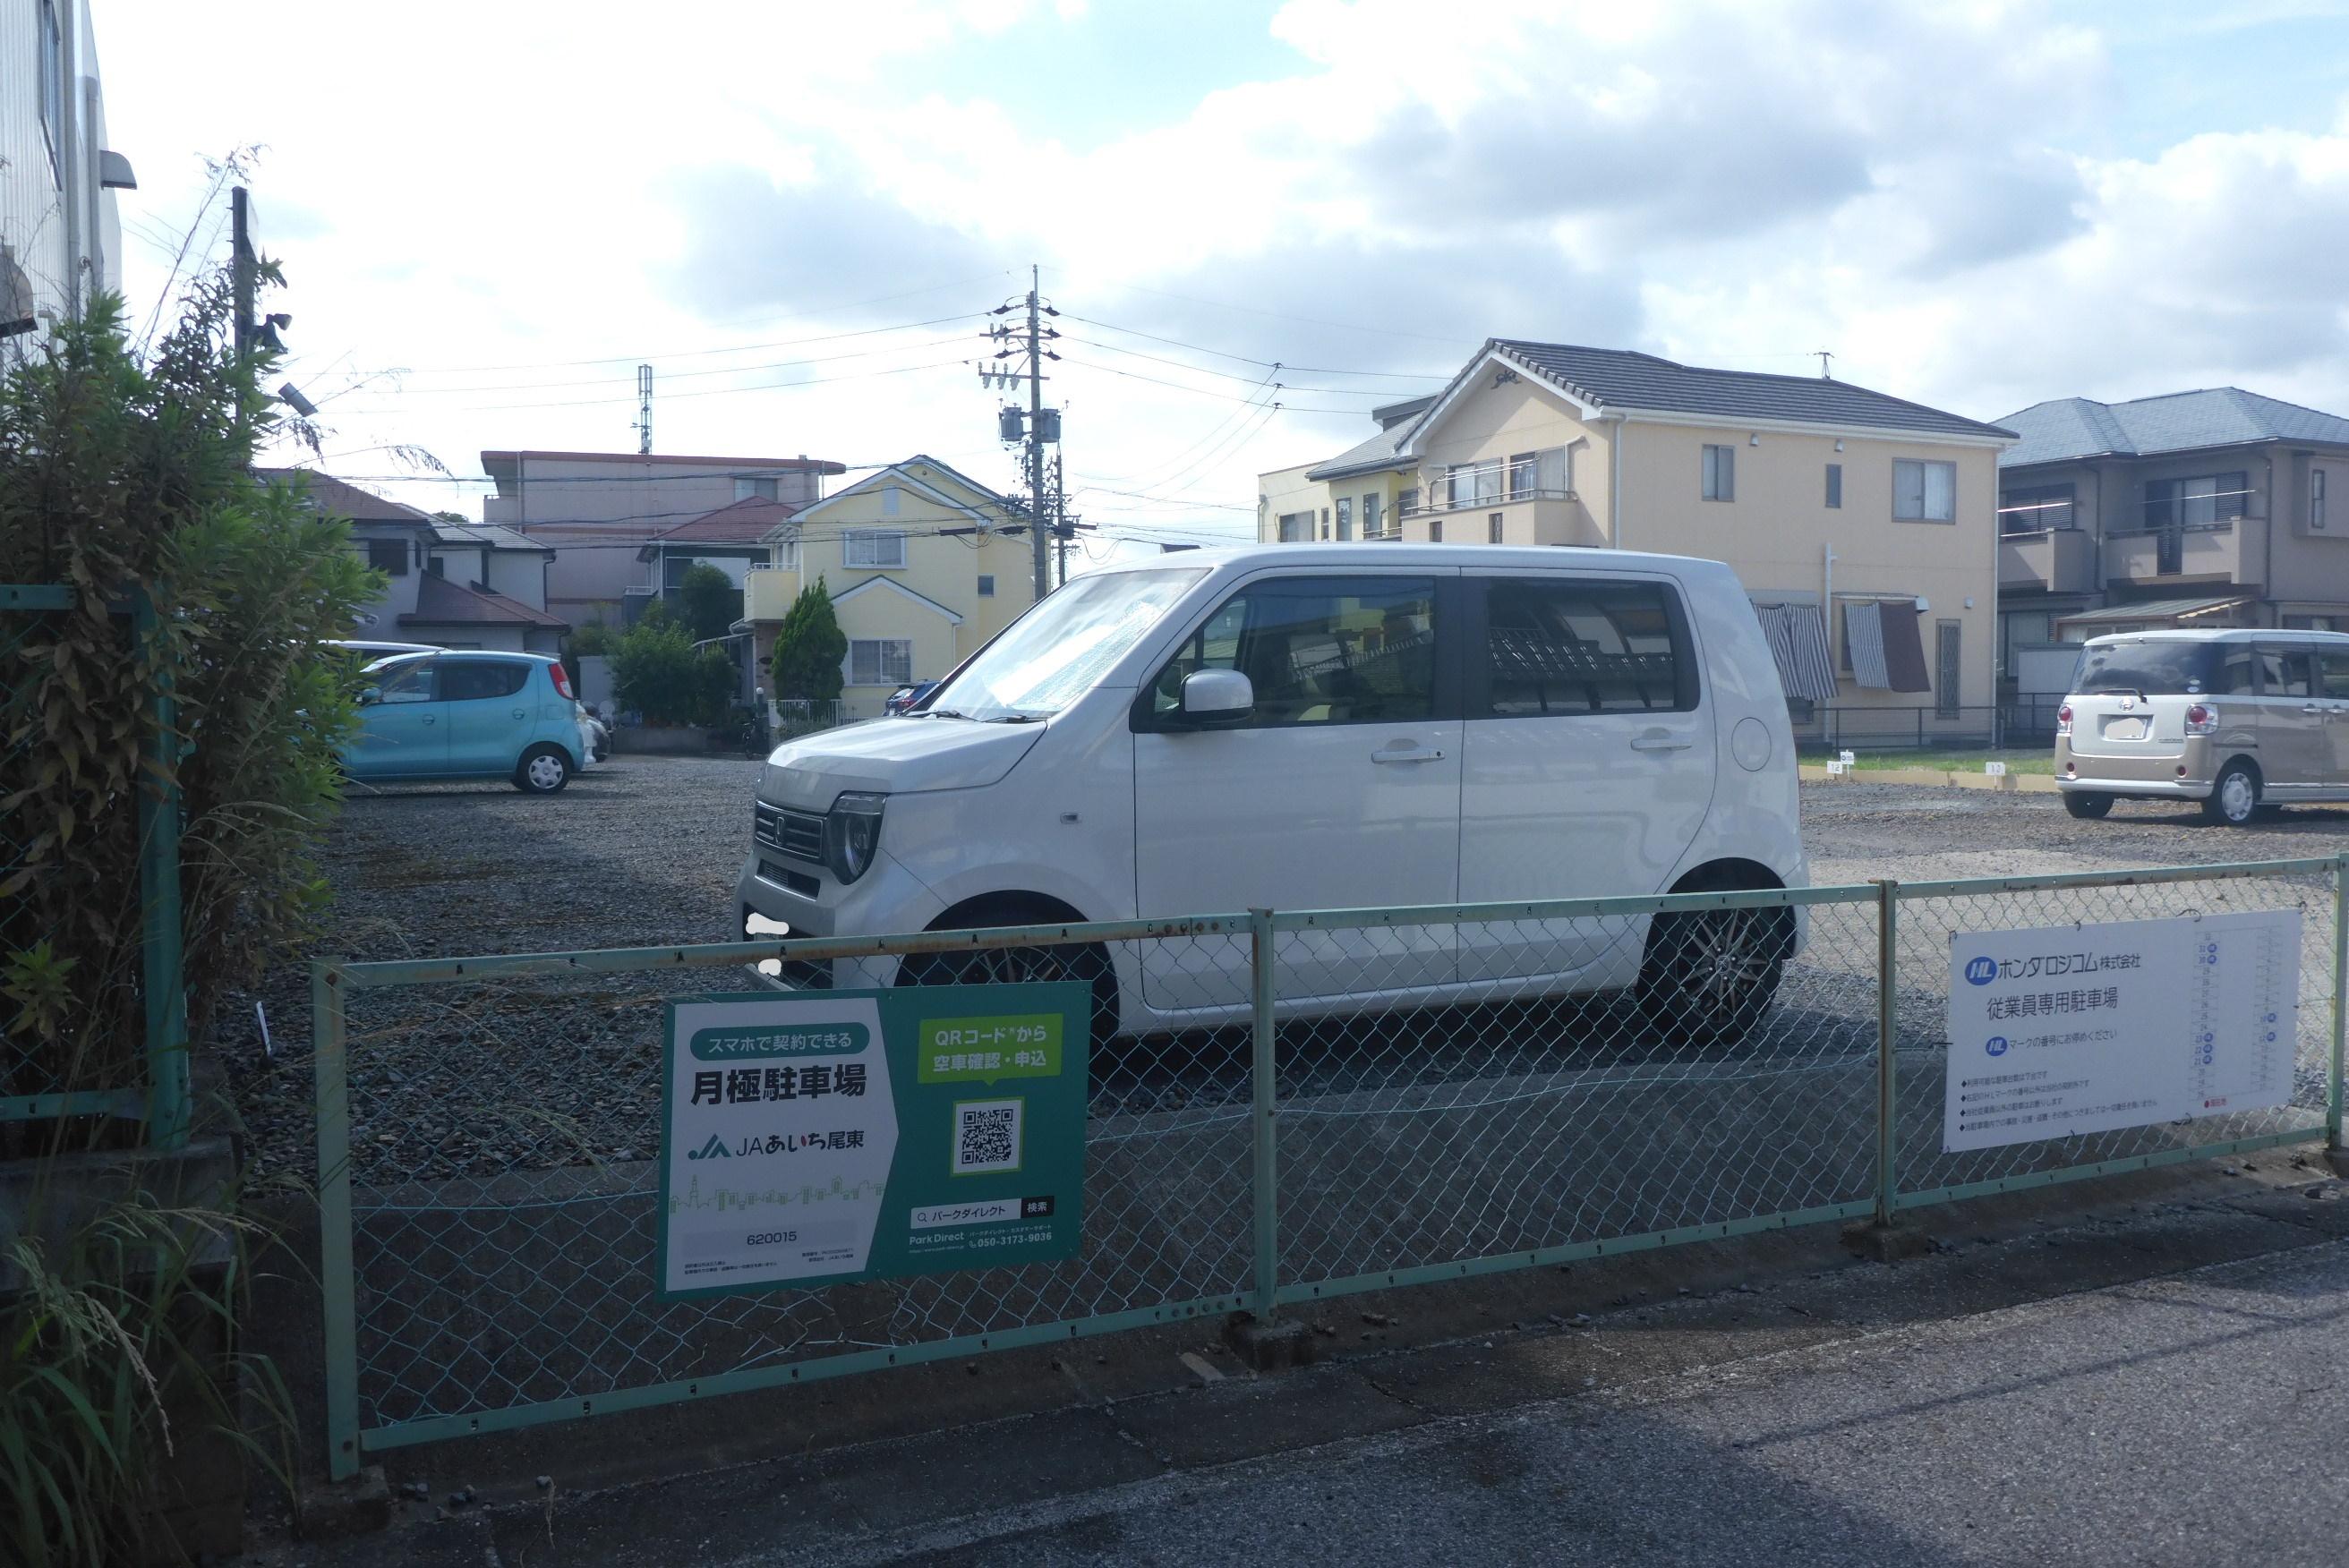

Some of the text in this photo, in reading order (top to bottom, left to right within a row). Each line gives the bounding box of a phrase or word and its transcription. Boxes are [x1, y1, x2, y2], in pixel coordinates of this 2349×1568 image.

[1986, 986, 2119, 1021] 従業員専用駐車場
[708, 1032, 853, 1053] スマホで契約できる
[2009, 1029, 2118, 1050] マークの番号にお停めください
[932, 1049, 1046, 1073] 空車確認・申込
[690, 1063, 867, 1106] 月極駐車場
[735, 1129, 866, 1157] JAあいち尾東
[931, 1205, 1007, 1223] パークダイレクト
[1026, 1201, 1048, 1214] 検索
[746, 1231, 798, 1246] 620015
[909, 1231, 964, 1246] Park Direct
[977, 1231, 1053, 1248] 050-3173-9036
